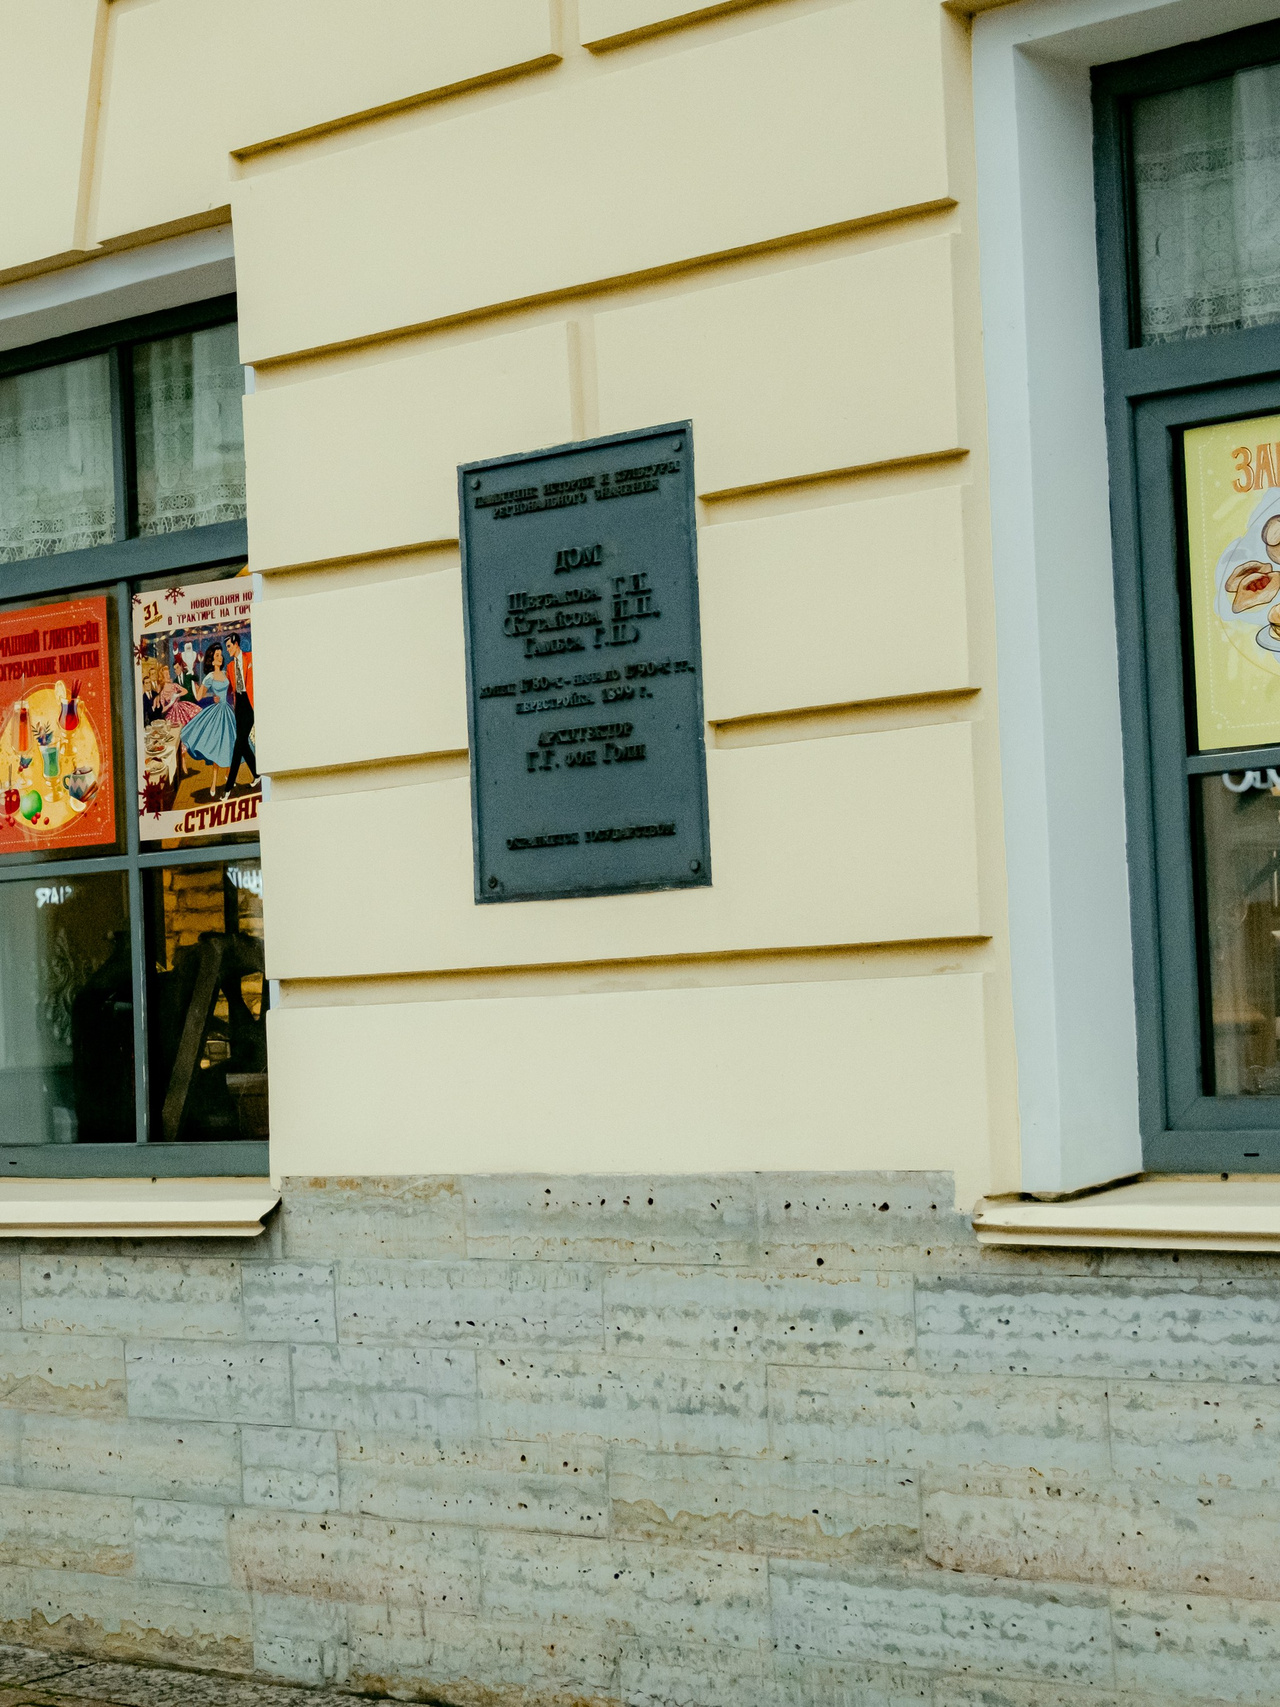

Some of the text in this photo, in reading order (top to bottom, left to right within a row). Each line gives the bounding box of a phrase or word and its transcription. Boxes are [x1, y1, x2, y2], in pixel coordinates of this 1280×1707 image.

[1231, 441, 1280, 493] ЗА
[554, 543, 602, 575] ДОМ
[143, 601, 159, 620] 31
[190, 591, 253, 610] НОВОГОДНЯЯ НО
[168, 616, 172, 625] В
[177, 609, 215, 624] ТРАКТИРЕ
[220, 607, 230, 617] НА
[42, 620, 99, 651] ГЛИНТВЕЙН
[58, 649, 100, 673] НАПИТКИ
[602, 686, 635, 703] 1899
